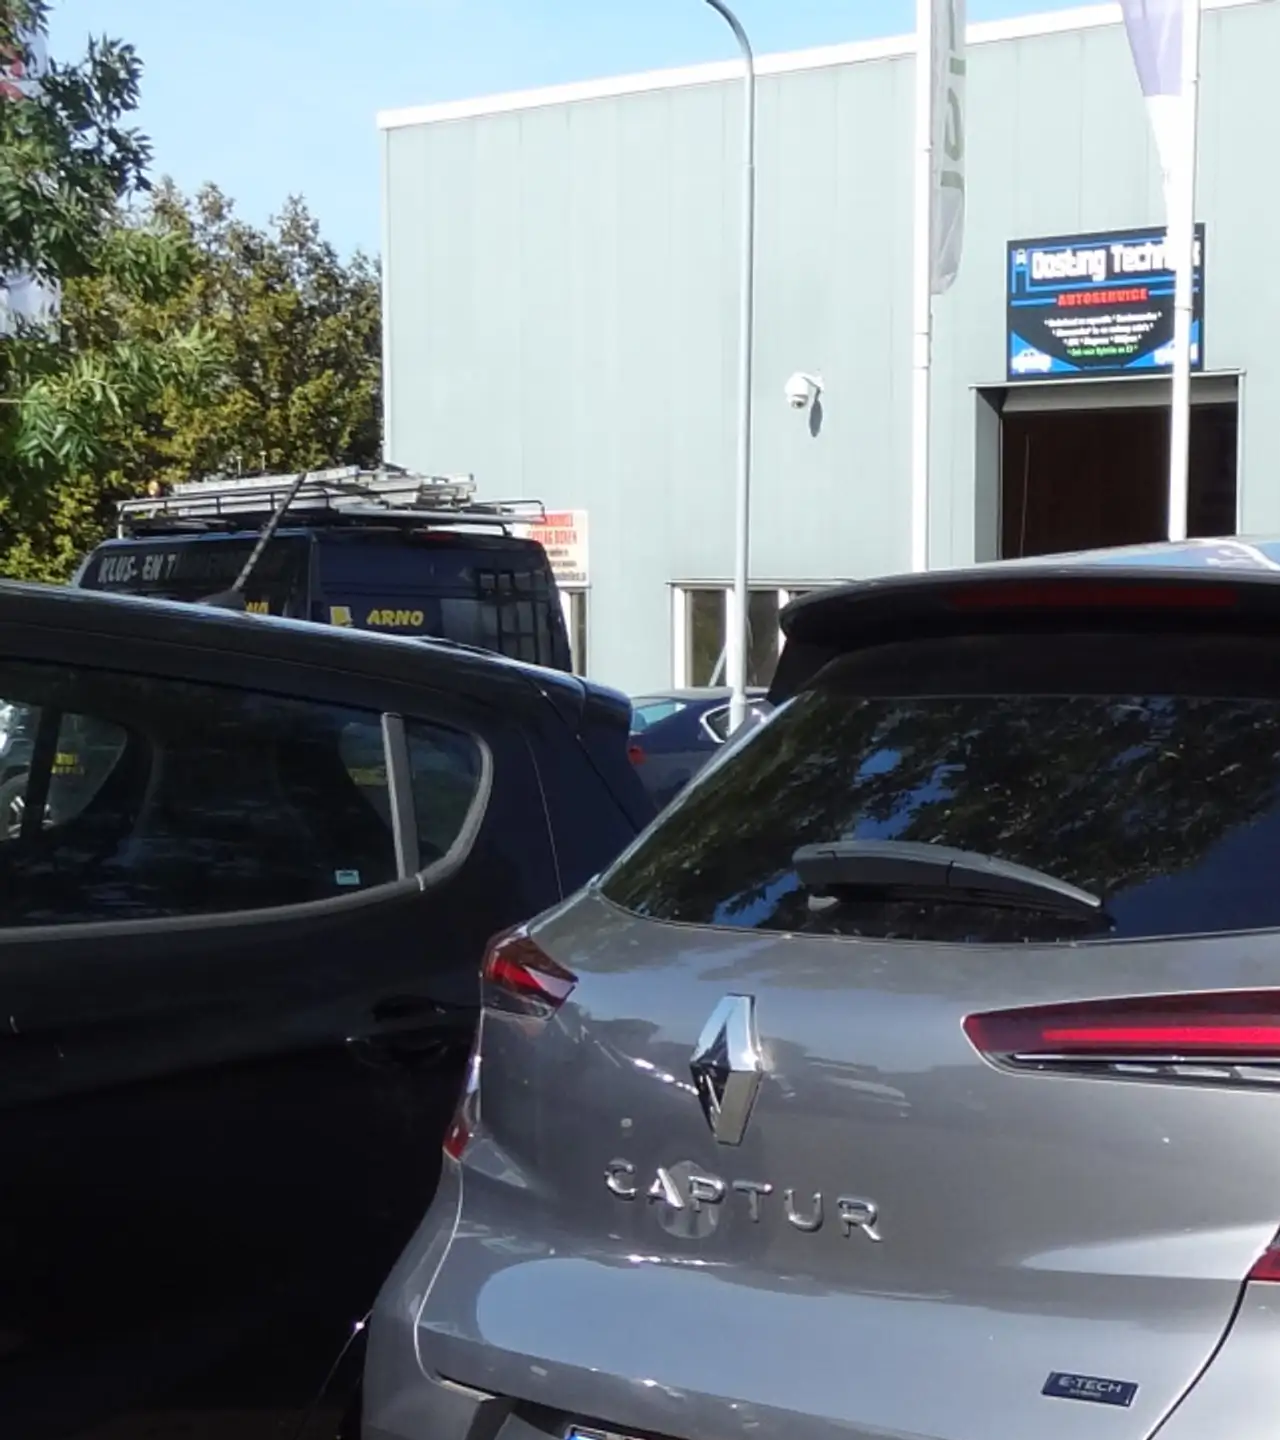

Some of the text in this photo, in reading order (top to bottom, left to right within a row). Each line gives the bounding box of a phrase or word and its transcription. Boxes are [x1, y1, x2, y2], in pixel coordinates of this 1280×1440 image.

[1057, 288, 1148, 306] AUTOSERVICE
[366, 608, 425, 626] ARNO
[604, 1157, 882, 1242] CAPTUR
